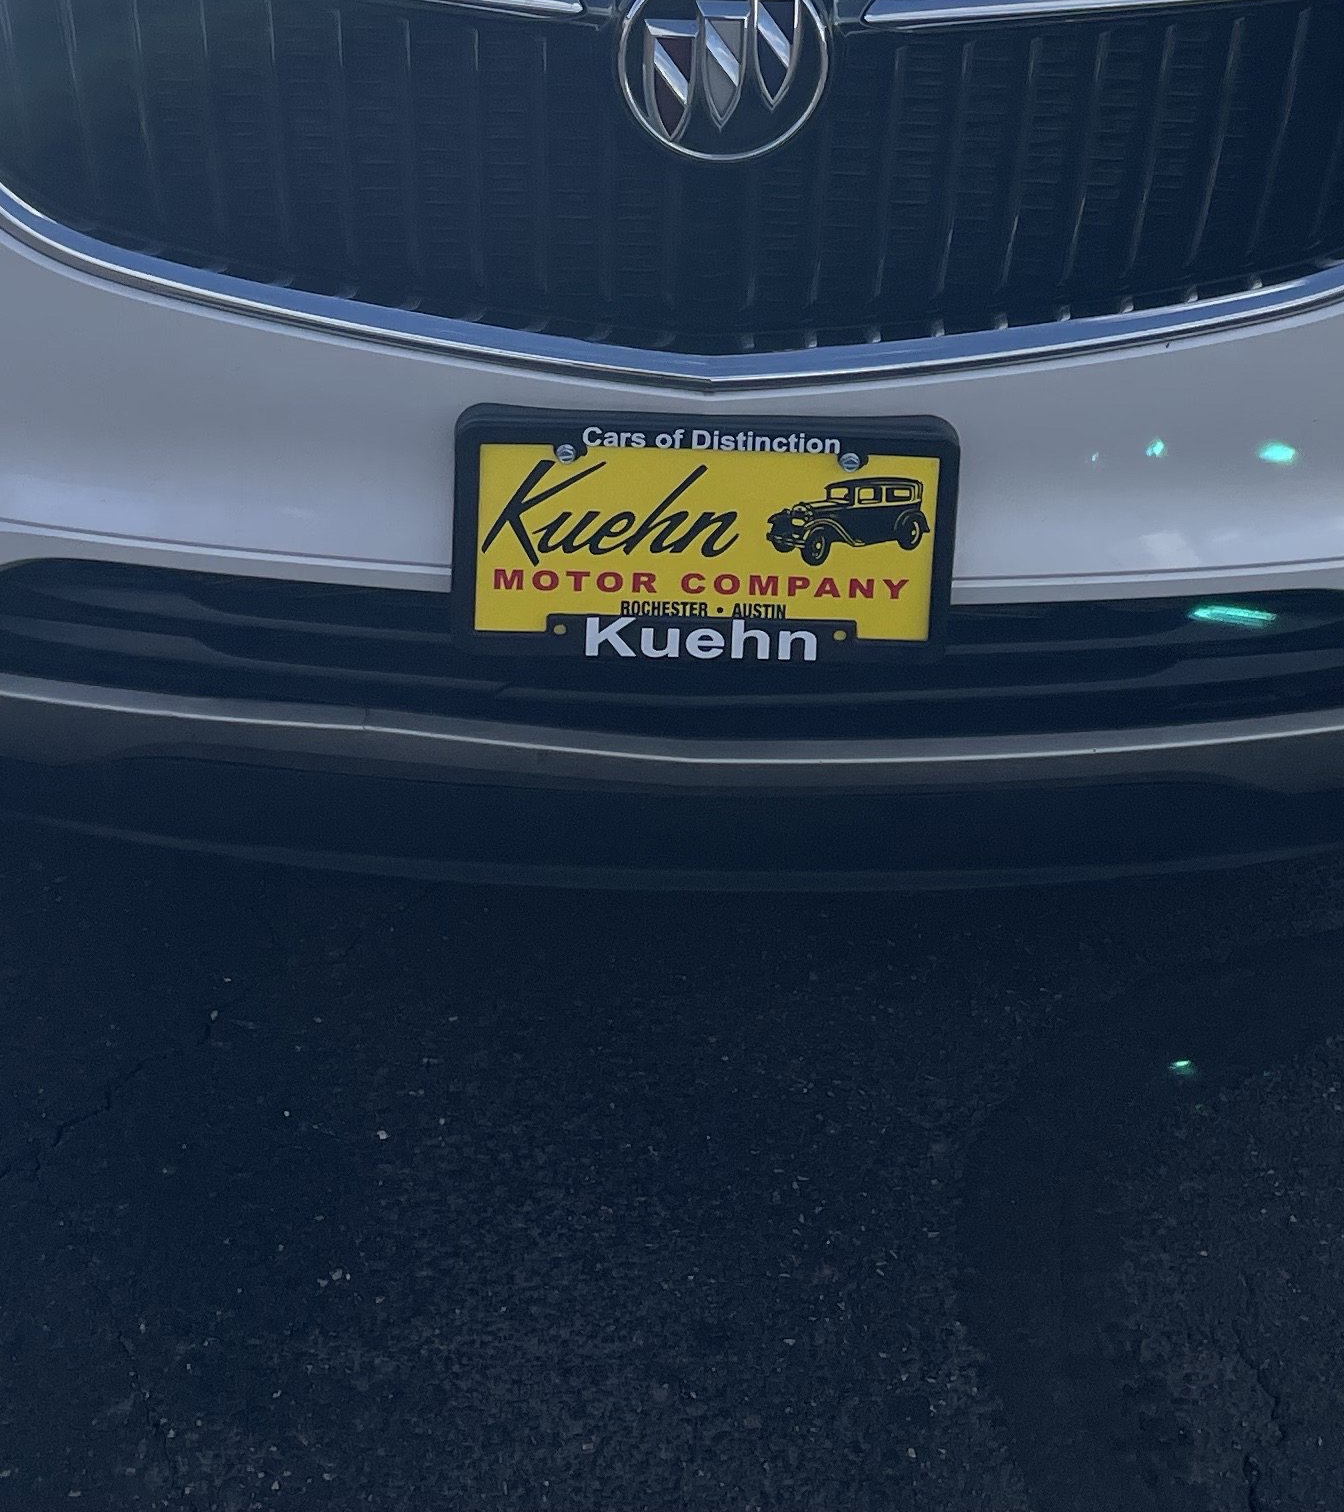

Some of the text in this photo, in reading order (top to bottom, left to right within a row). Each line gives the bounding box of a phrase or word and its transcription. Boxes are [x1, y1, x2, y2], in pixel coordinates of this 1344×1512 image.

[582, 426, 841, 454] Cars of Distinction
[481, 459, 739, 567] Kuehn
[493, 568, 910, 600] MOTOR COMPANY
[621, 600, 787, 620] ROCHESTER AUSTIN
[584, 616, 818, 662] Kuehn
